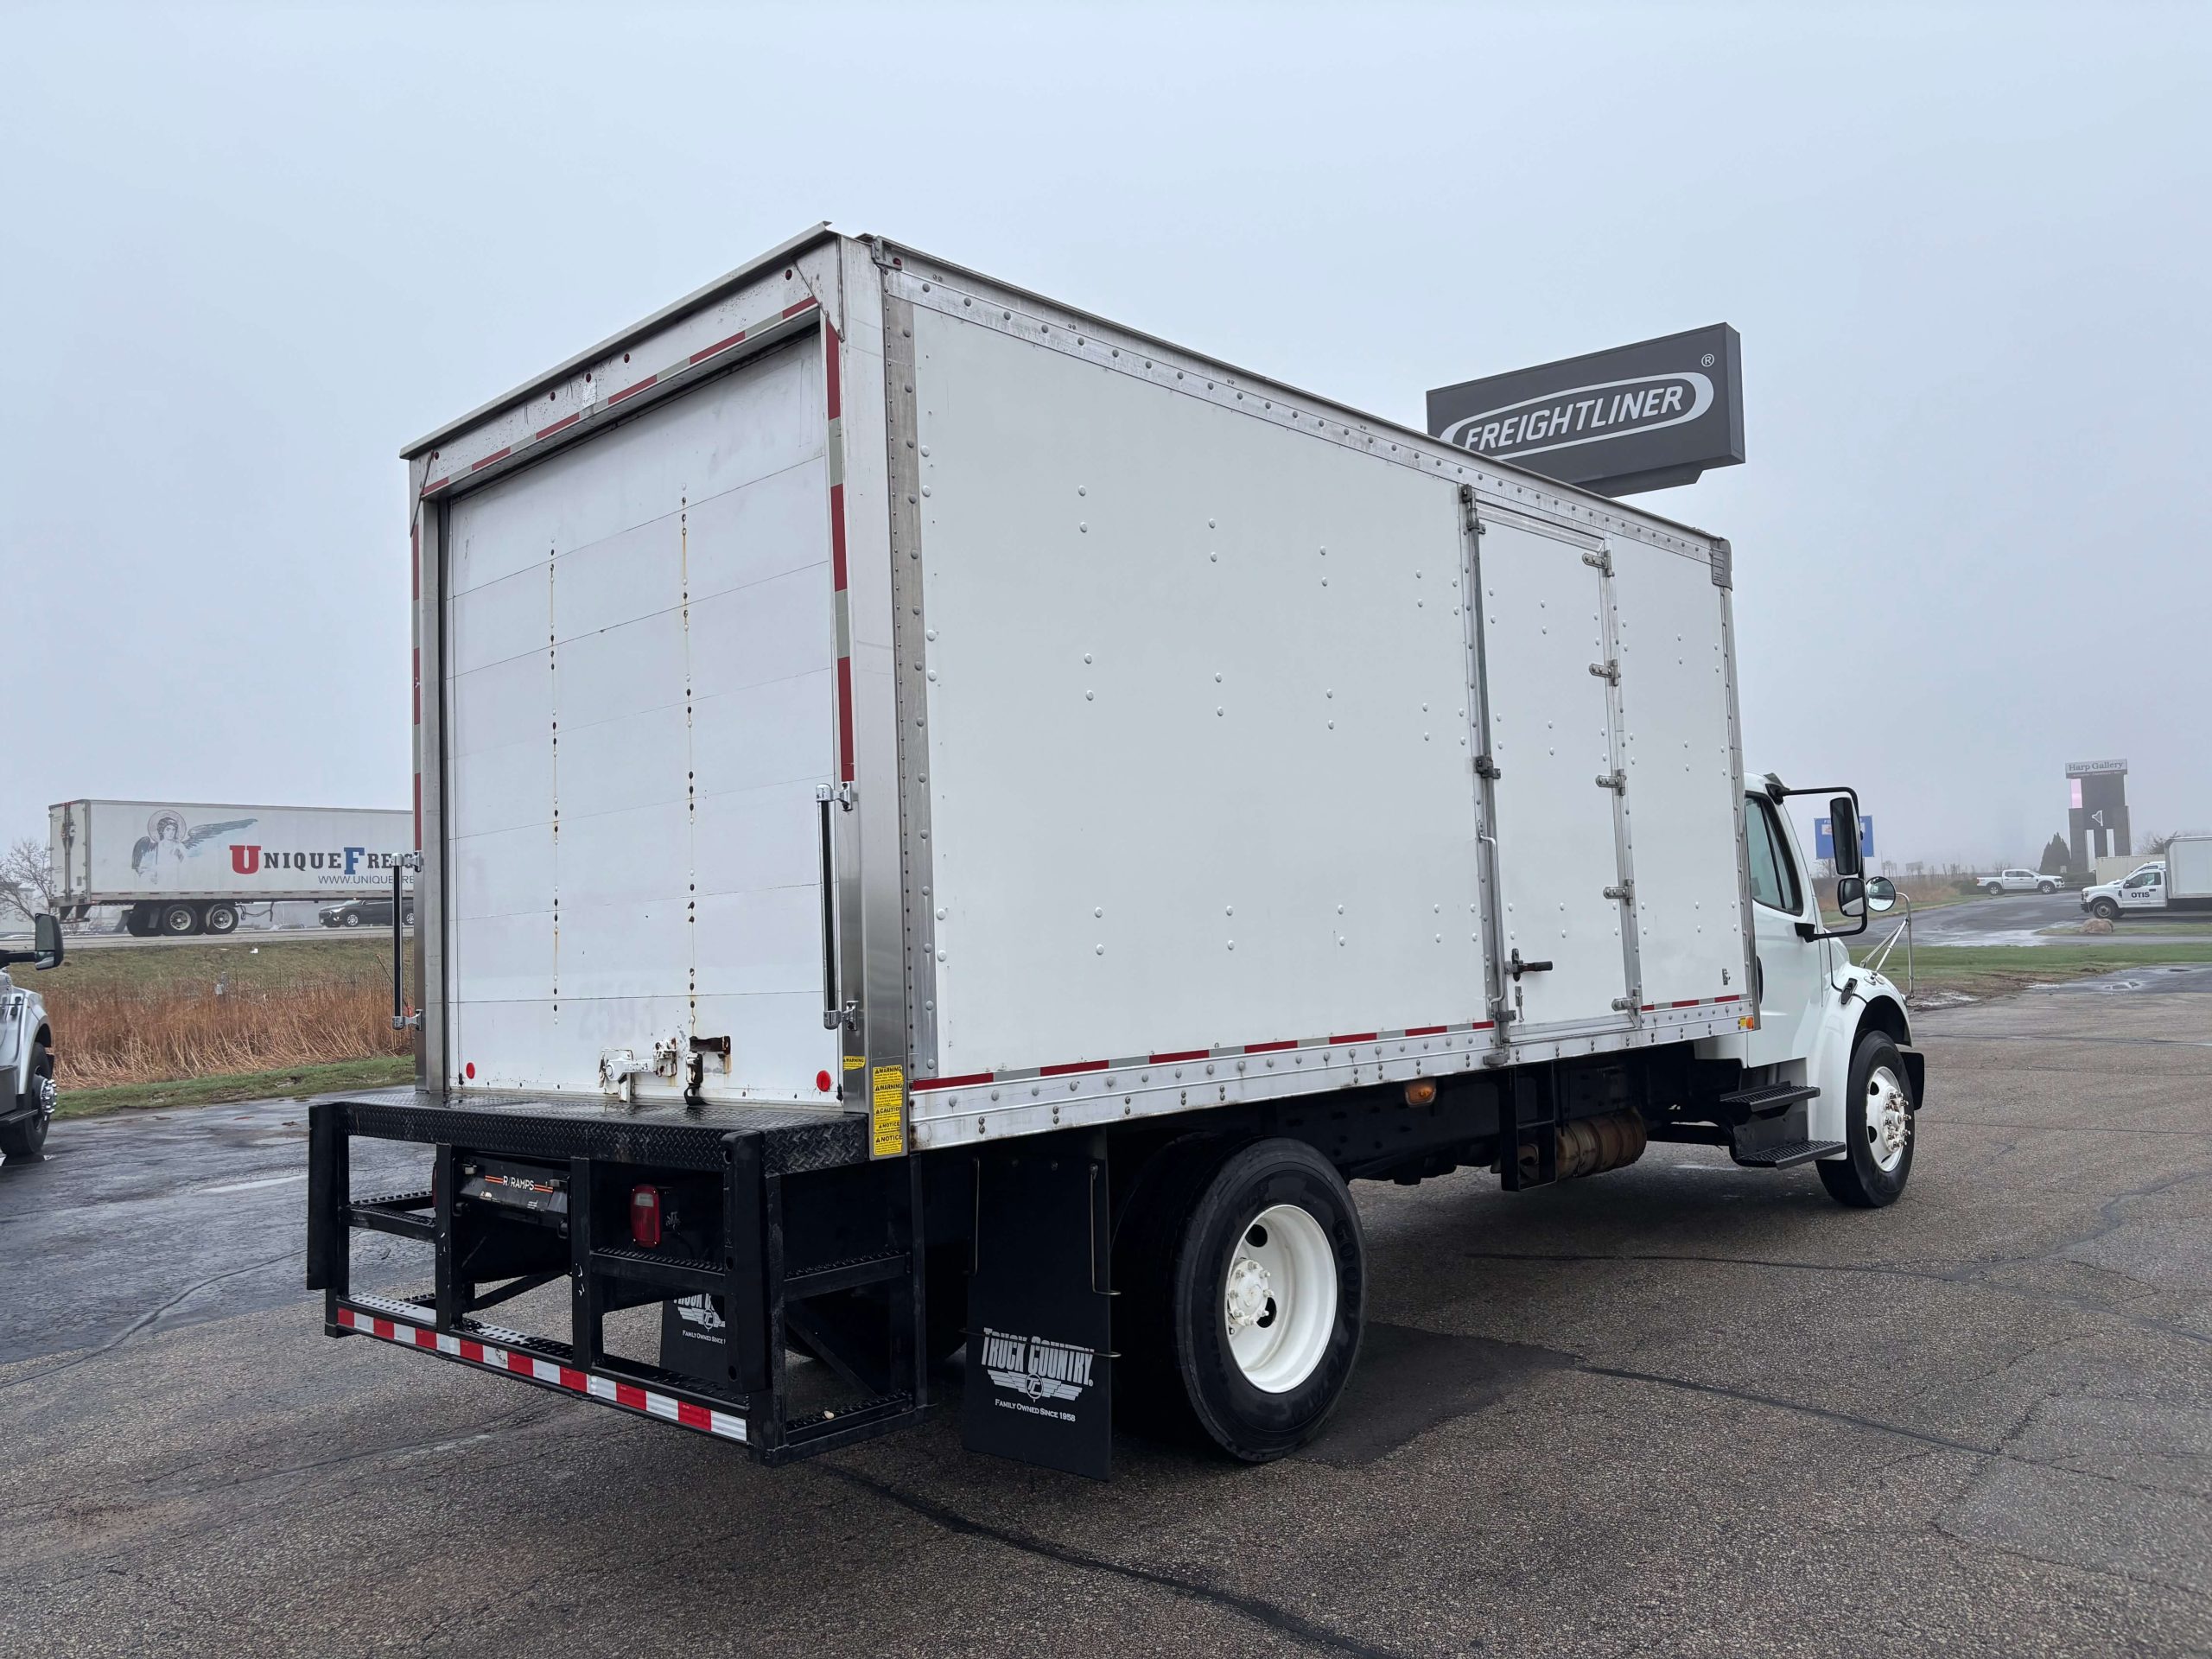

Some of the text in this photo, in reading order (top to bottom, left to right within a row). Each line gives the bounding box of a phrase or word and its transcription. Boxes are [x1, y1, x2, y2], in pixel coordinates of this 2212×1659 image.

[1465, 385, 1684, 451] FREIGHTLINER
[318, 875, 414, 884] WWW.UNIQUERE
[982, 1327, 1094, 1386] TRUCK COUNTRY
[995, 1398, 1076, 1422] FAMILY OWNED SINCE 1958
